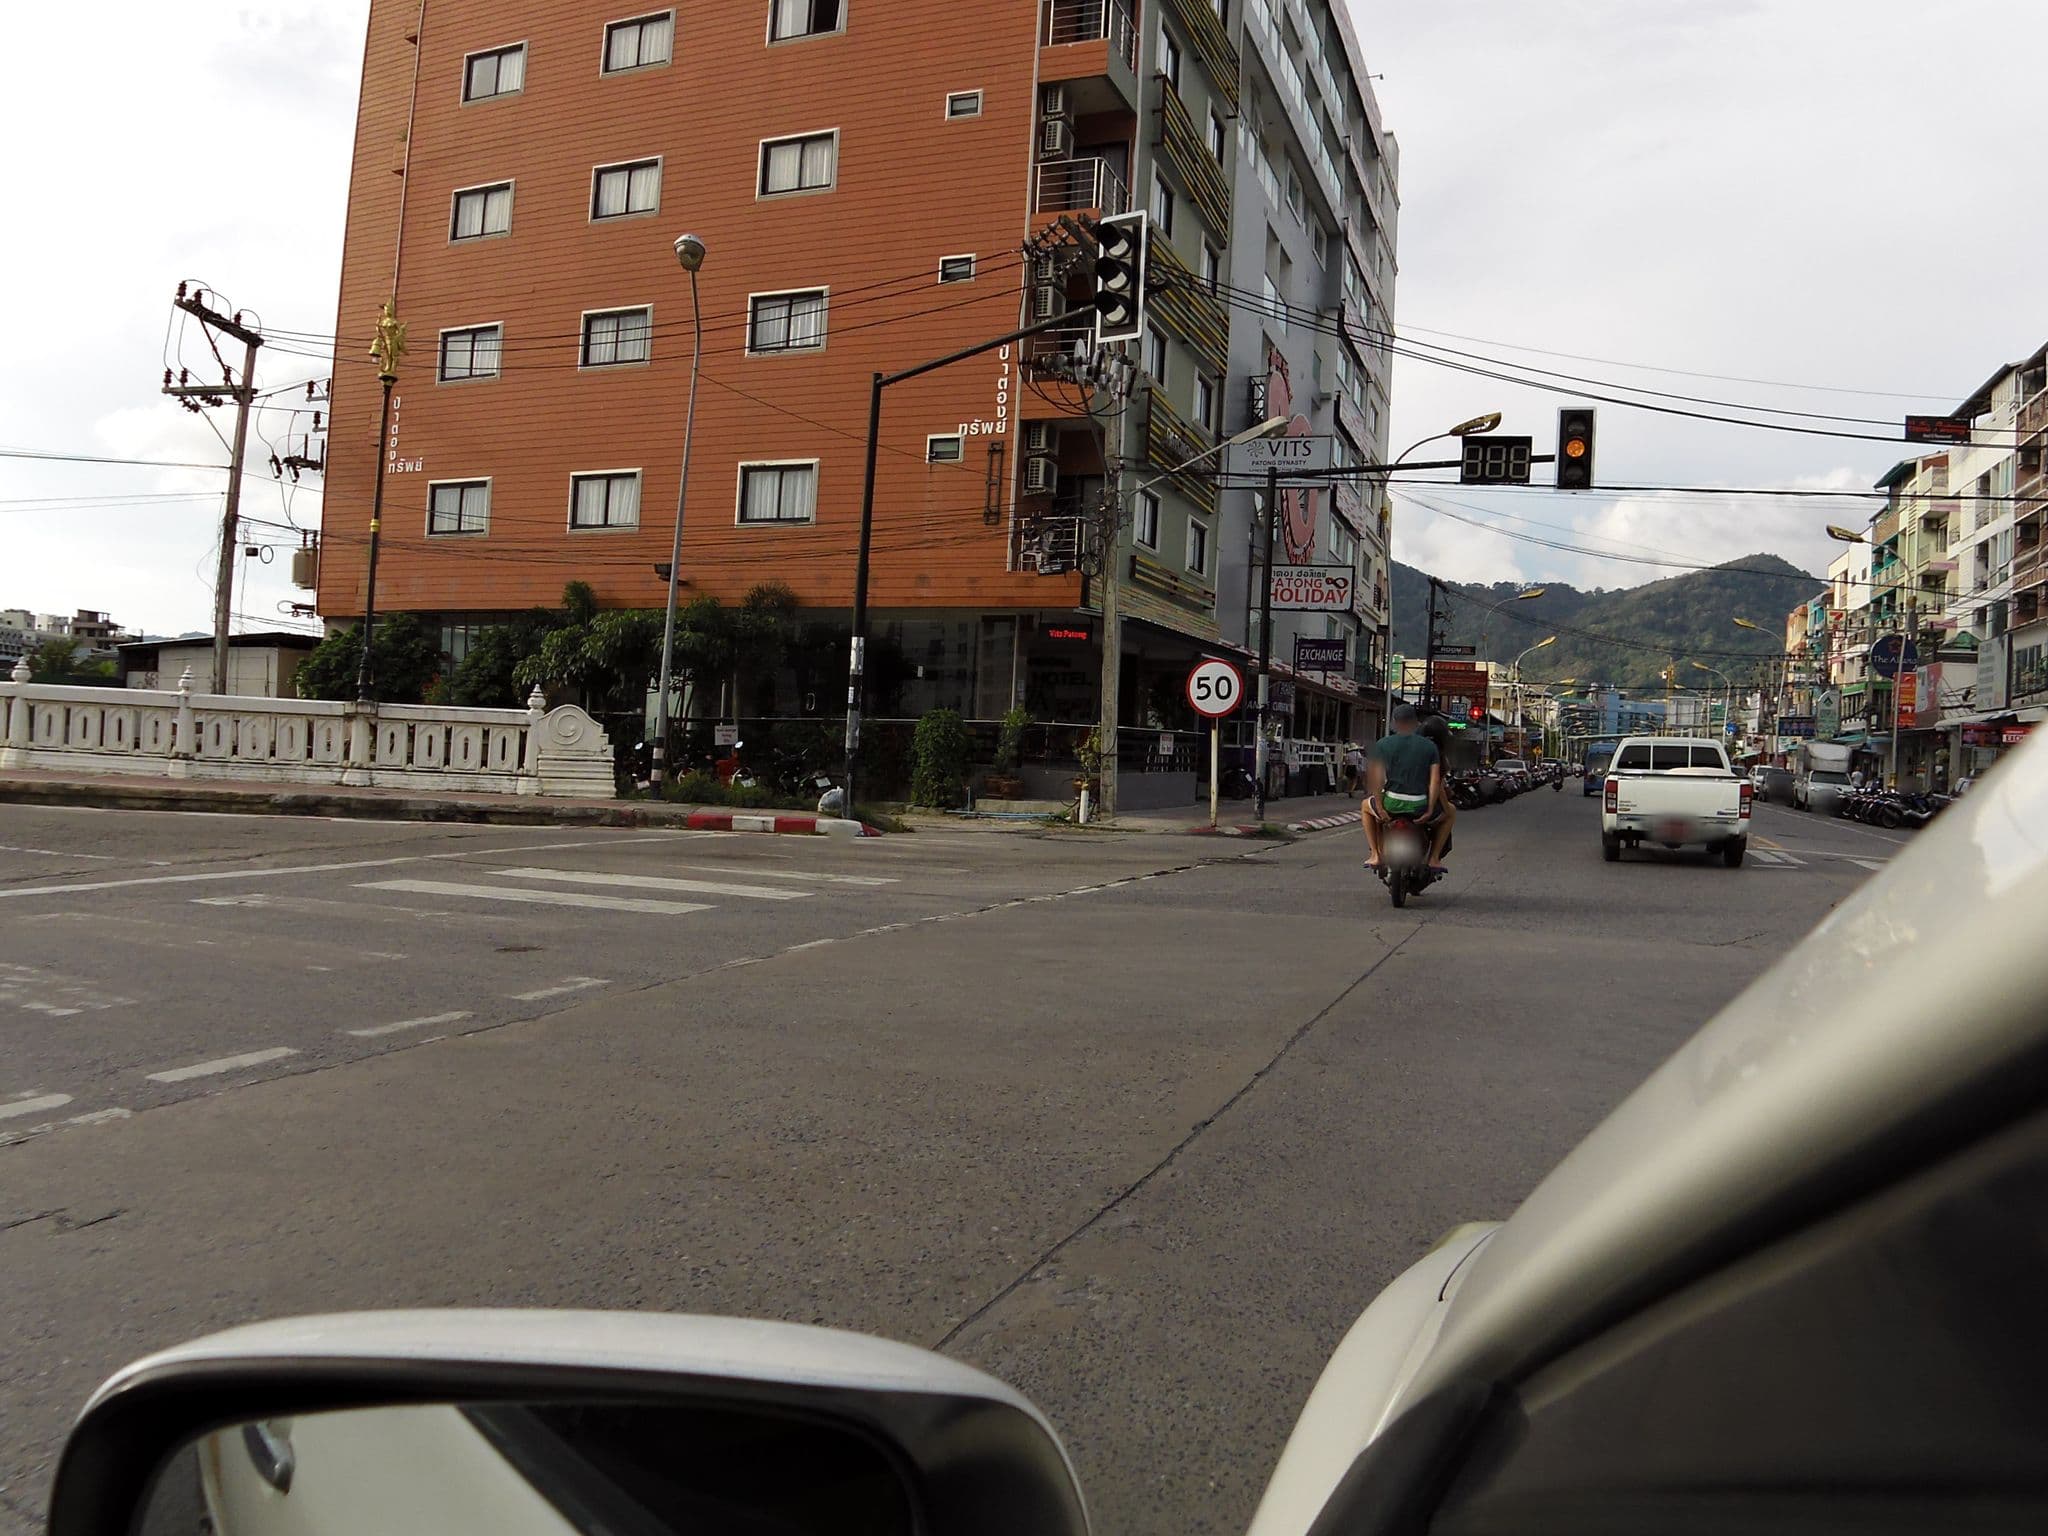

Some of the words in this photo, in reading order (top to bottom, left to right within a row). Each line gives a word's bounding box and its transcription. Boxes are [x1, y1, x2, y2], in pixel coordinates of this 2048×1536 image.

[1267, 439, 1313, 457] VITS
[1300, 648, 1344, 661] EXCHANGE
[1196, 675, 1233, 700] 50
